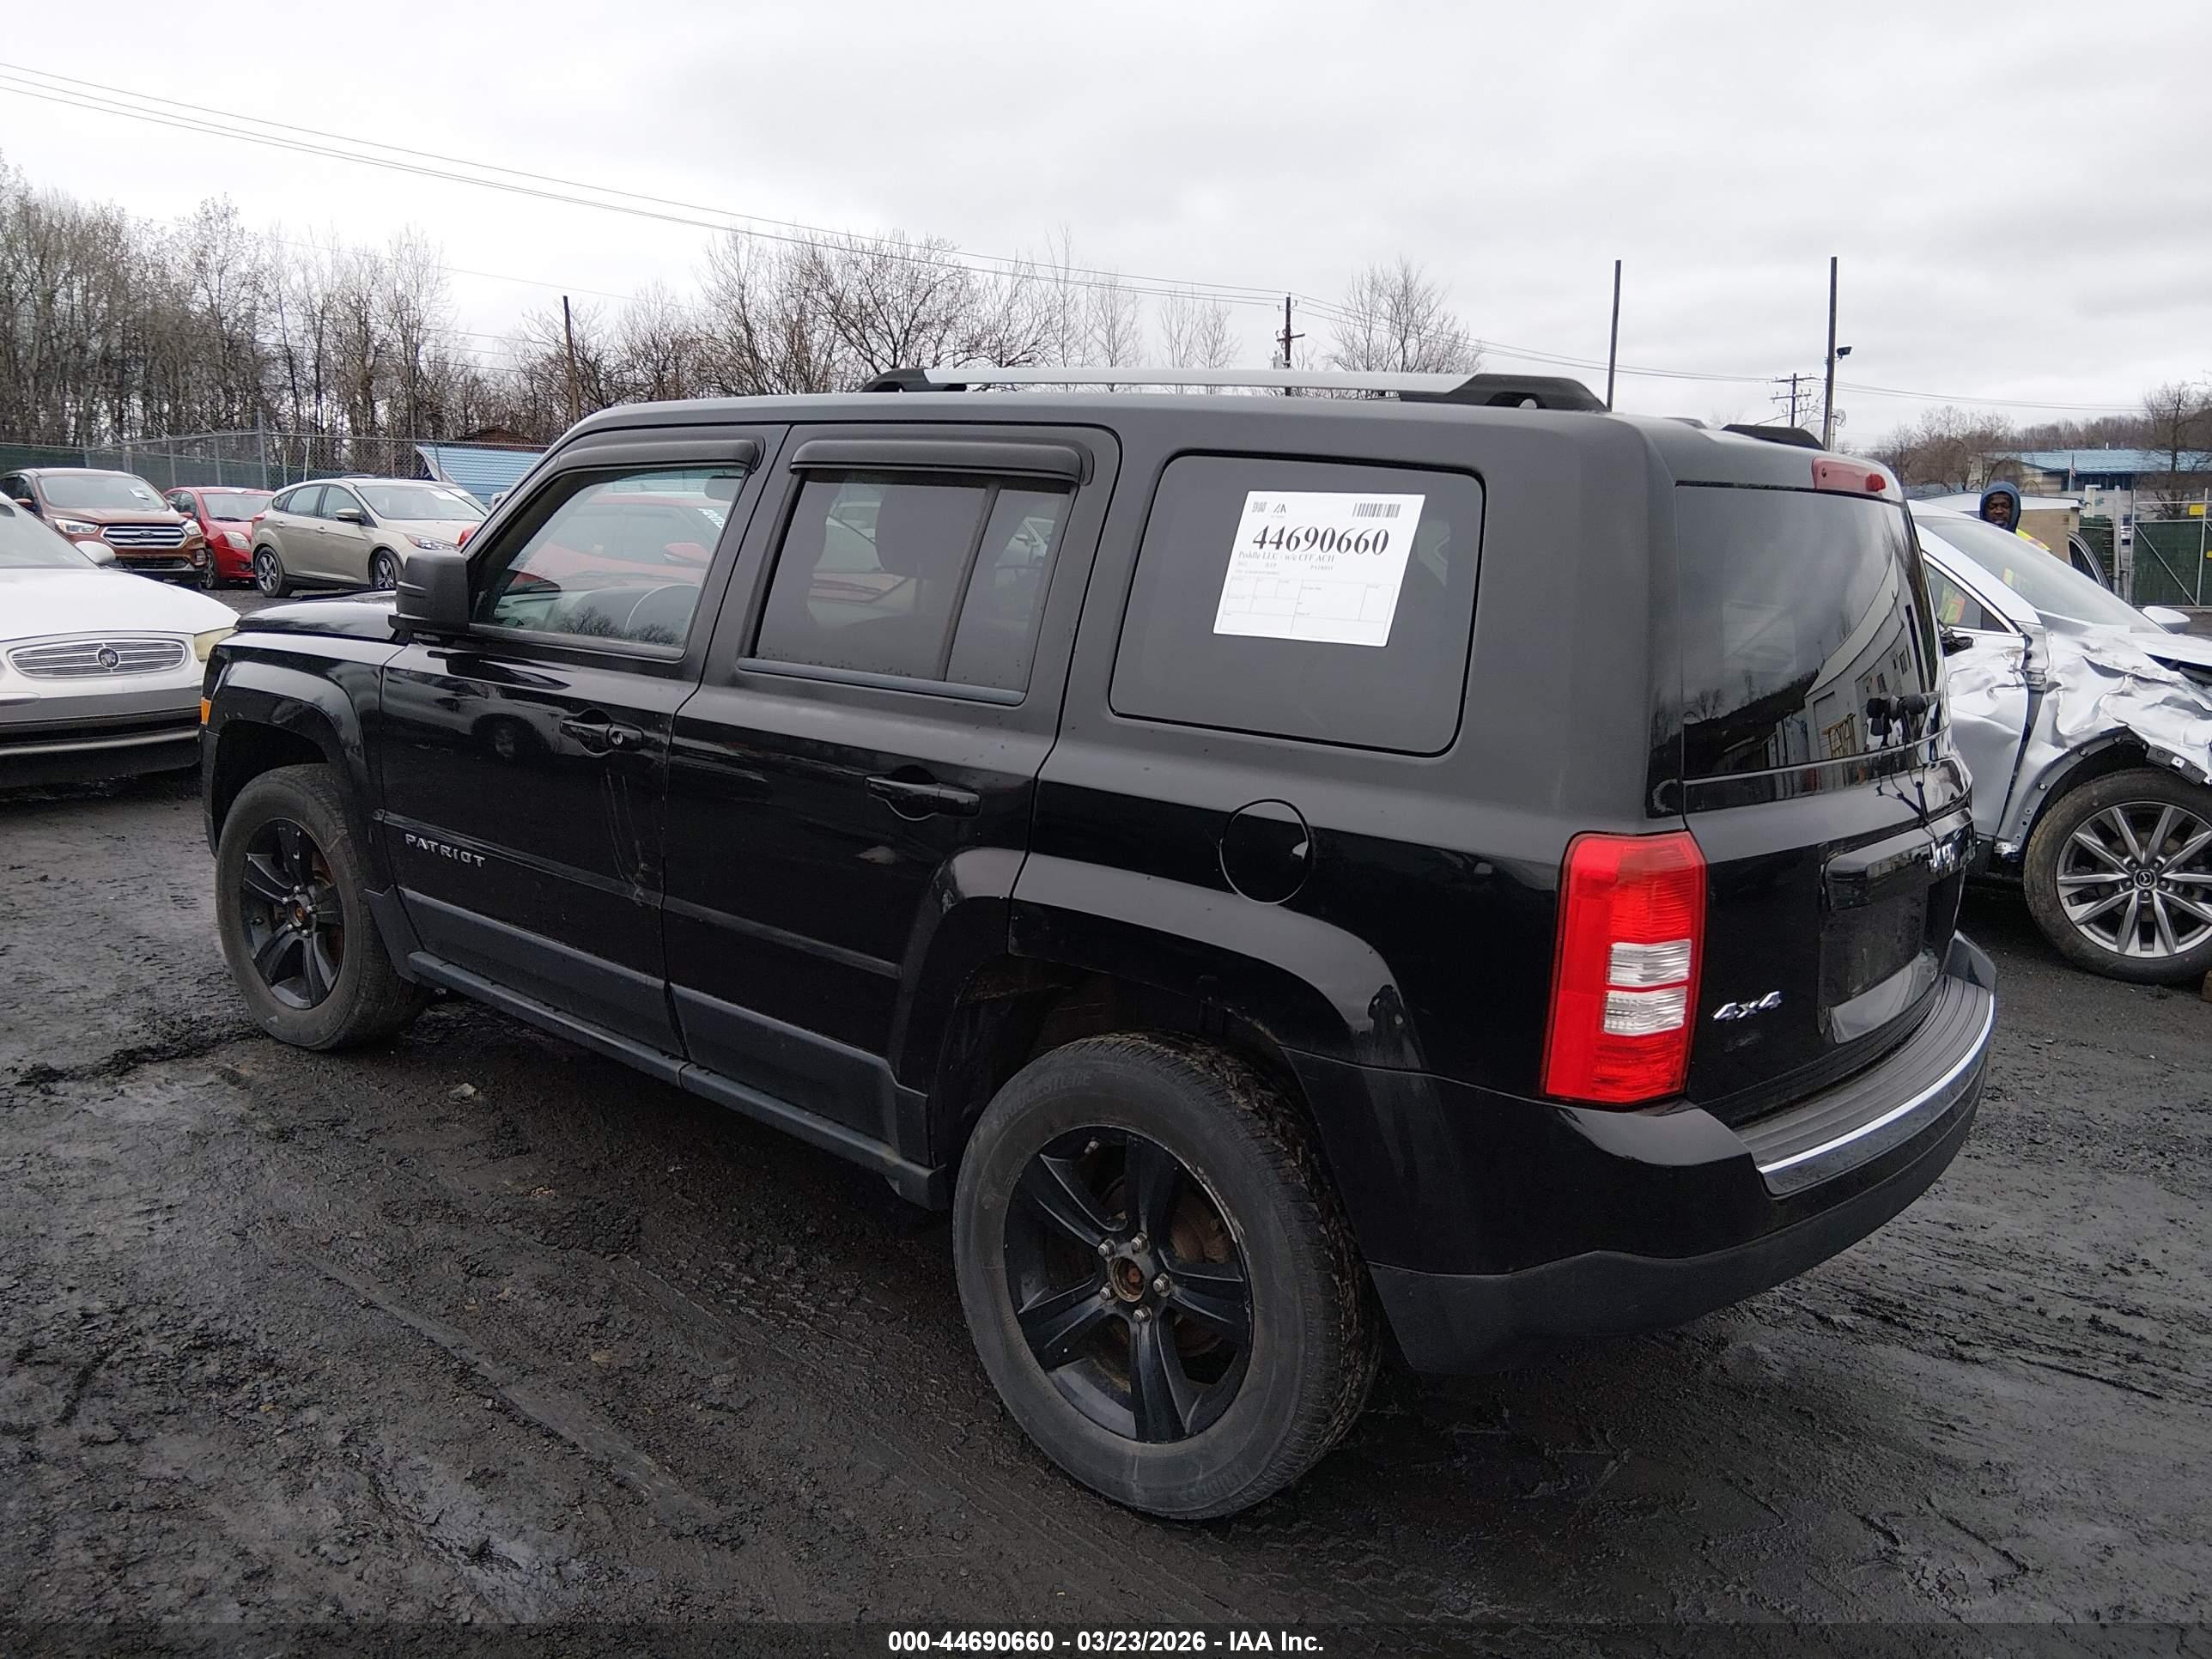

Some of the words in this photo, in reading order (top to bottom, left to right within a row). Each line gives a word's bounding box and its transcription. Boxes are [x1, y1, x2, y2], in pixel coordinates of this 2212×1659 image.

[1252, 525, 1389, 556] 44690660
[405, 833, 486, 867] PATRIOT
[1712, 990, 1782, 1021] 4x4
